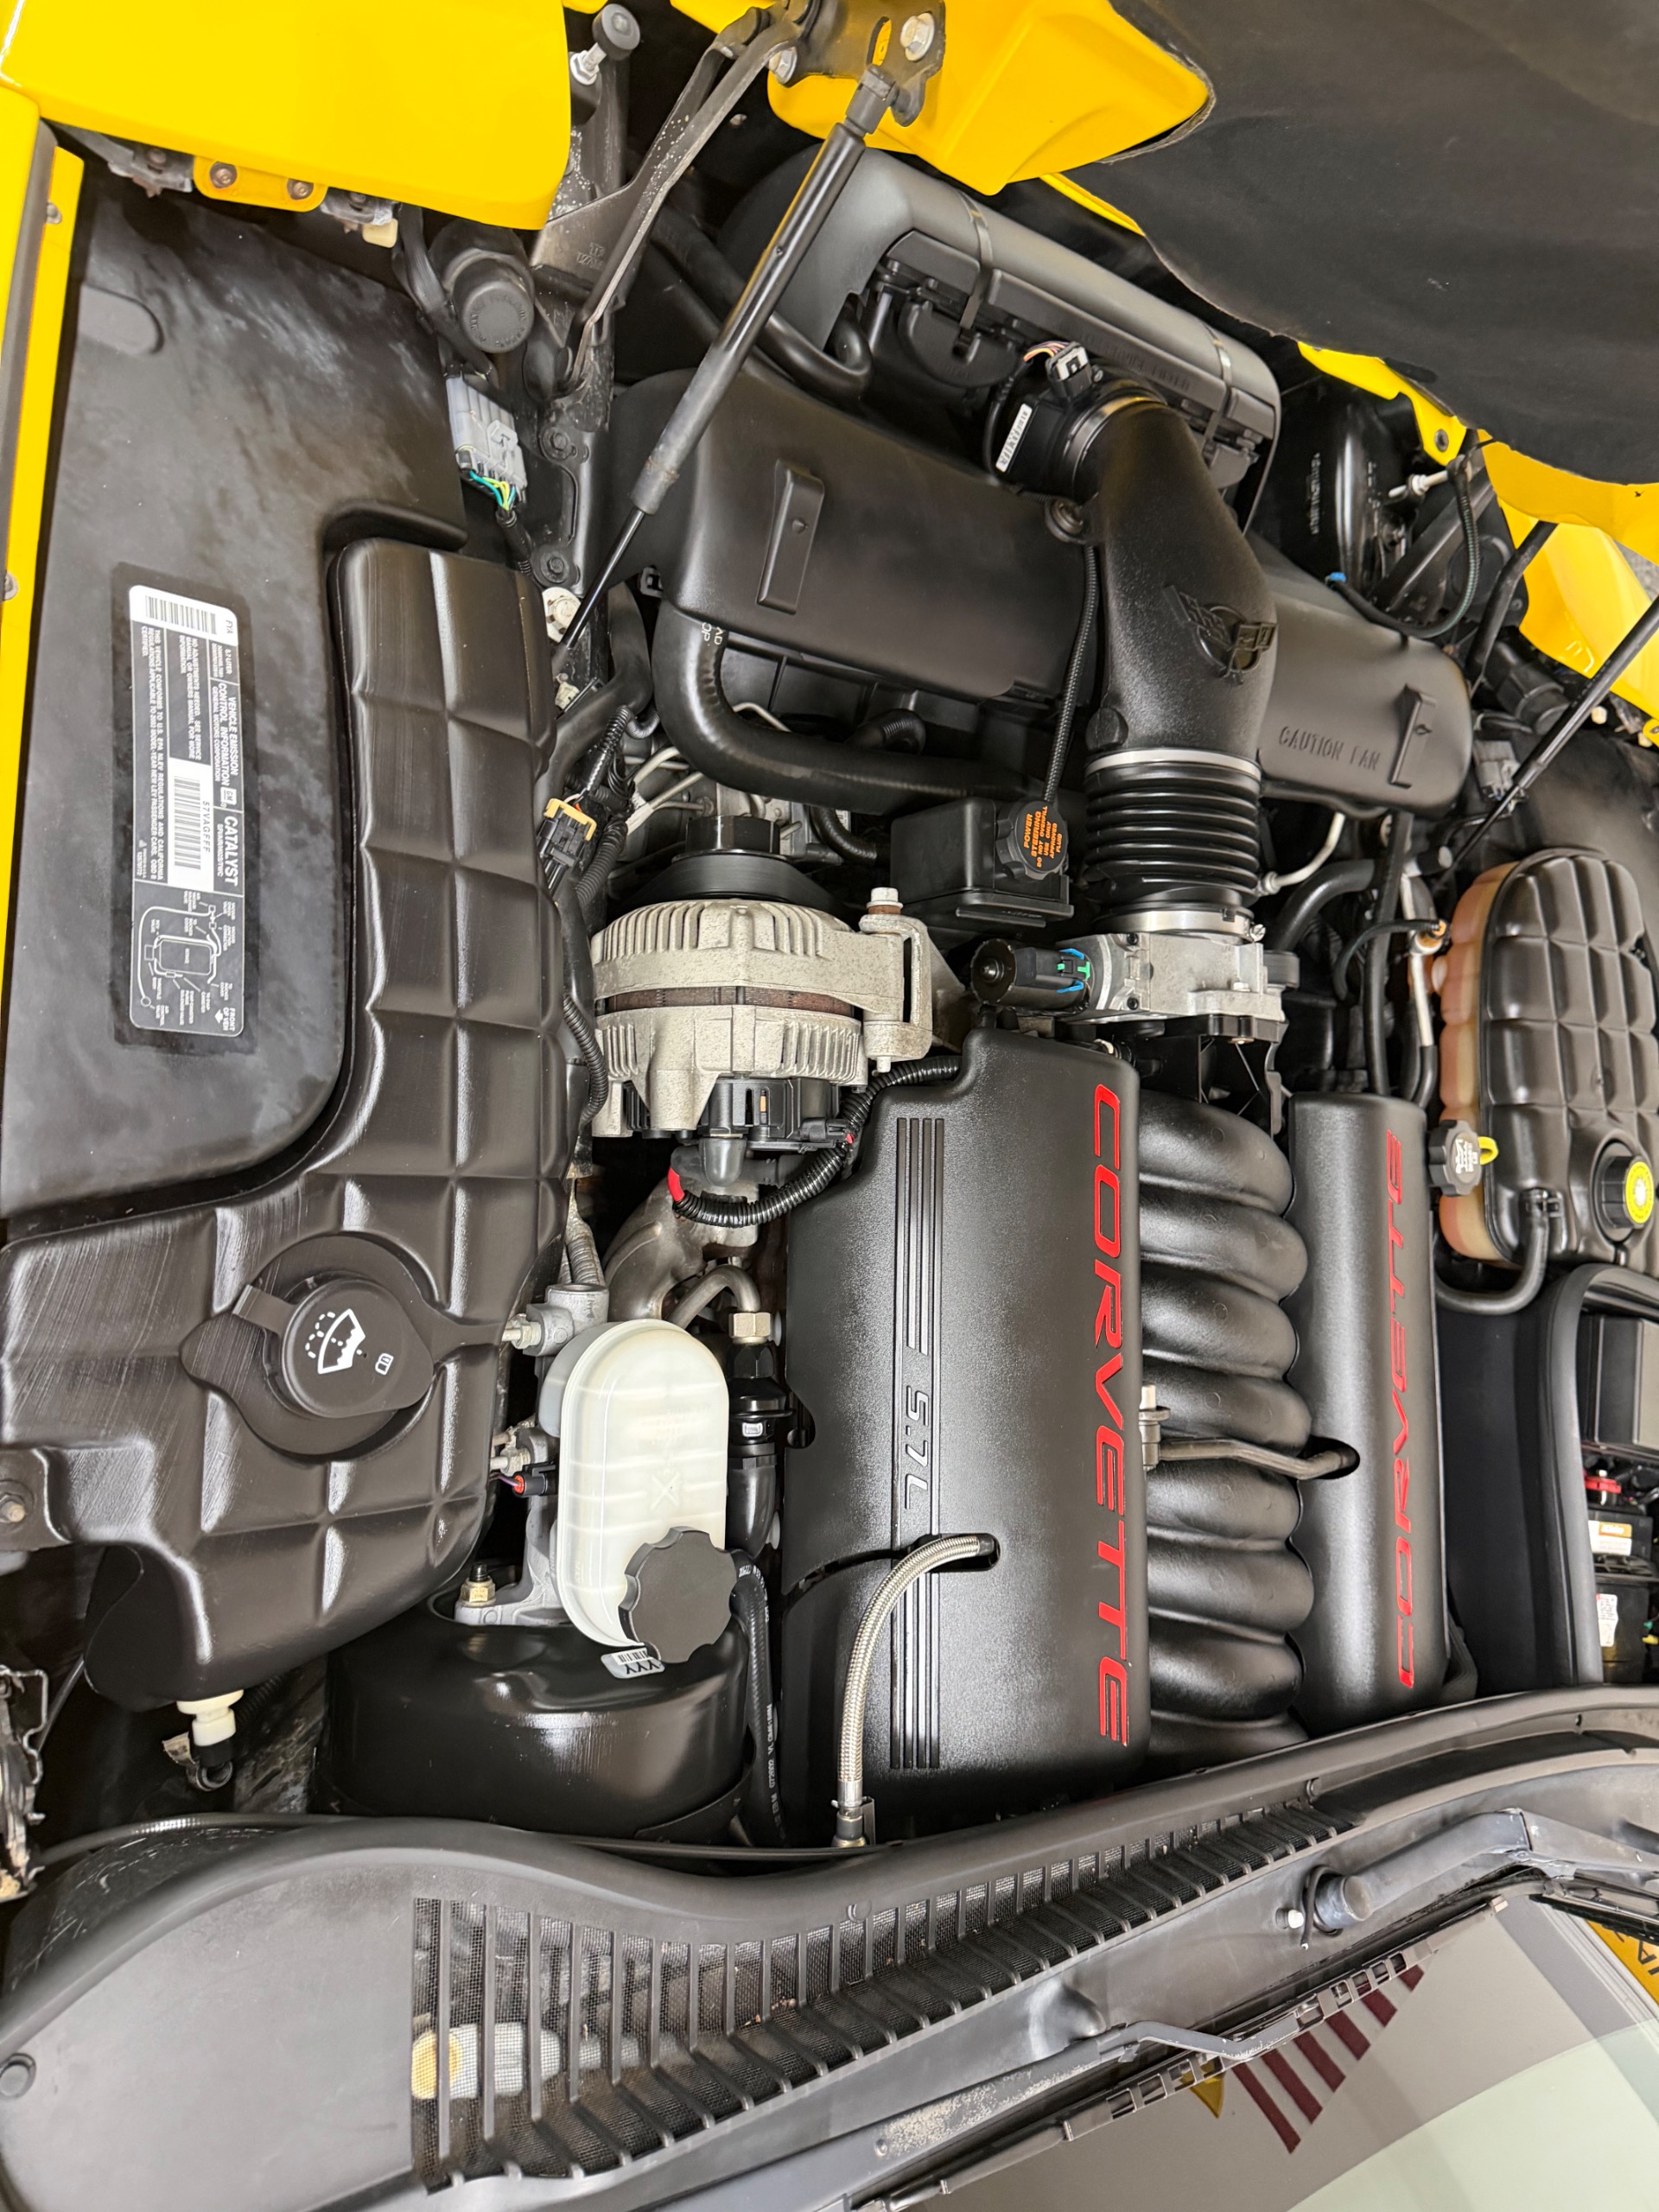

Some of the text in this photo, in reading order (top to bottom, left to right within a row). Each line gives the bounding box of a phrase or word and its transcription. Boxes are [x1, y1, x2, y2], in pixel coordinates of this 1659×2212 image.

[702, 622, 712, 641] OP
[714, 627, 723, 645] AD
[187, 662, 193, 671] OR
[157, 712, 163, 721] TO
[219, 683, 228, 722] CONTROL
[228, 697, 238, 775] VEHICLE EMISSION
[1279, 726, 1344, 761] CAUTION
[219, 727, 230, 785] INFORMATION
[1023, 814, 1033, 849] POWER
[1031, 811, 1041, 857] STEERING
[224, 816, 238, 887] CATALYST
[1037, 857, 1042, 868] DO
[223, 1007, 229, 1017] OF
[1094, 1084, 1128, 1746] CORVETTE
[1387, 1130, 1414, 1688] CORVETTE
[905, 1386, 929, 1510] 5.7L
